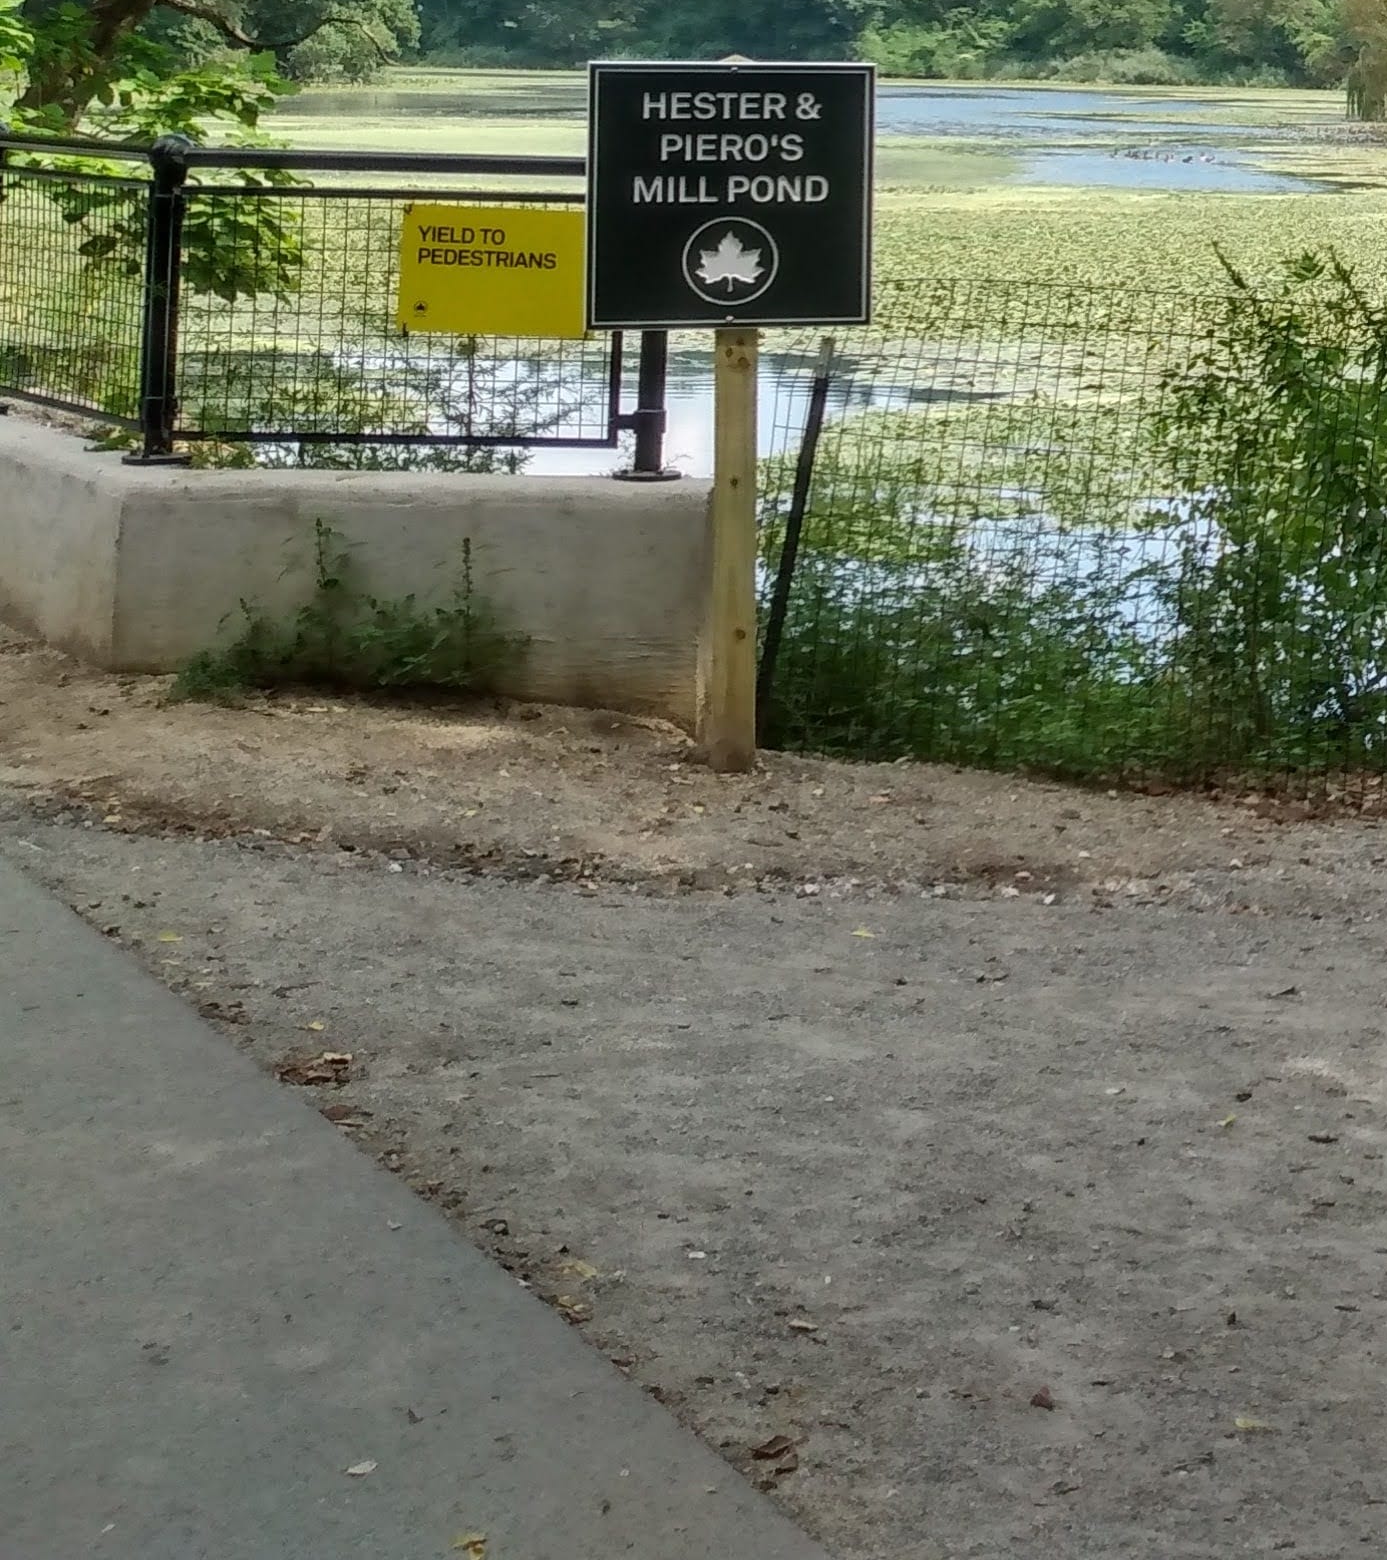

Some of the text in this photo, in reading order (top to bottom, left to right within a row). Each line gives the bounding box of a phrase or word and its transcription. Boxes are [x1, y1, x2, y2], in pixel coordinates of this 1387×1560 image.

[642, 92, 823, 120] HESTER &
[660, 134, 804, 161] PIERO'S
[633, 175, 829, 203] MILL POND
[418, 226, 505, 245] YIELD TO
[418, 248, 557, 269] PEDESTRIANS
